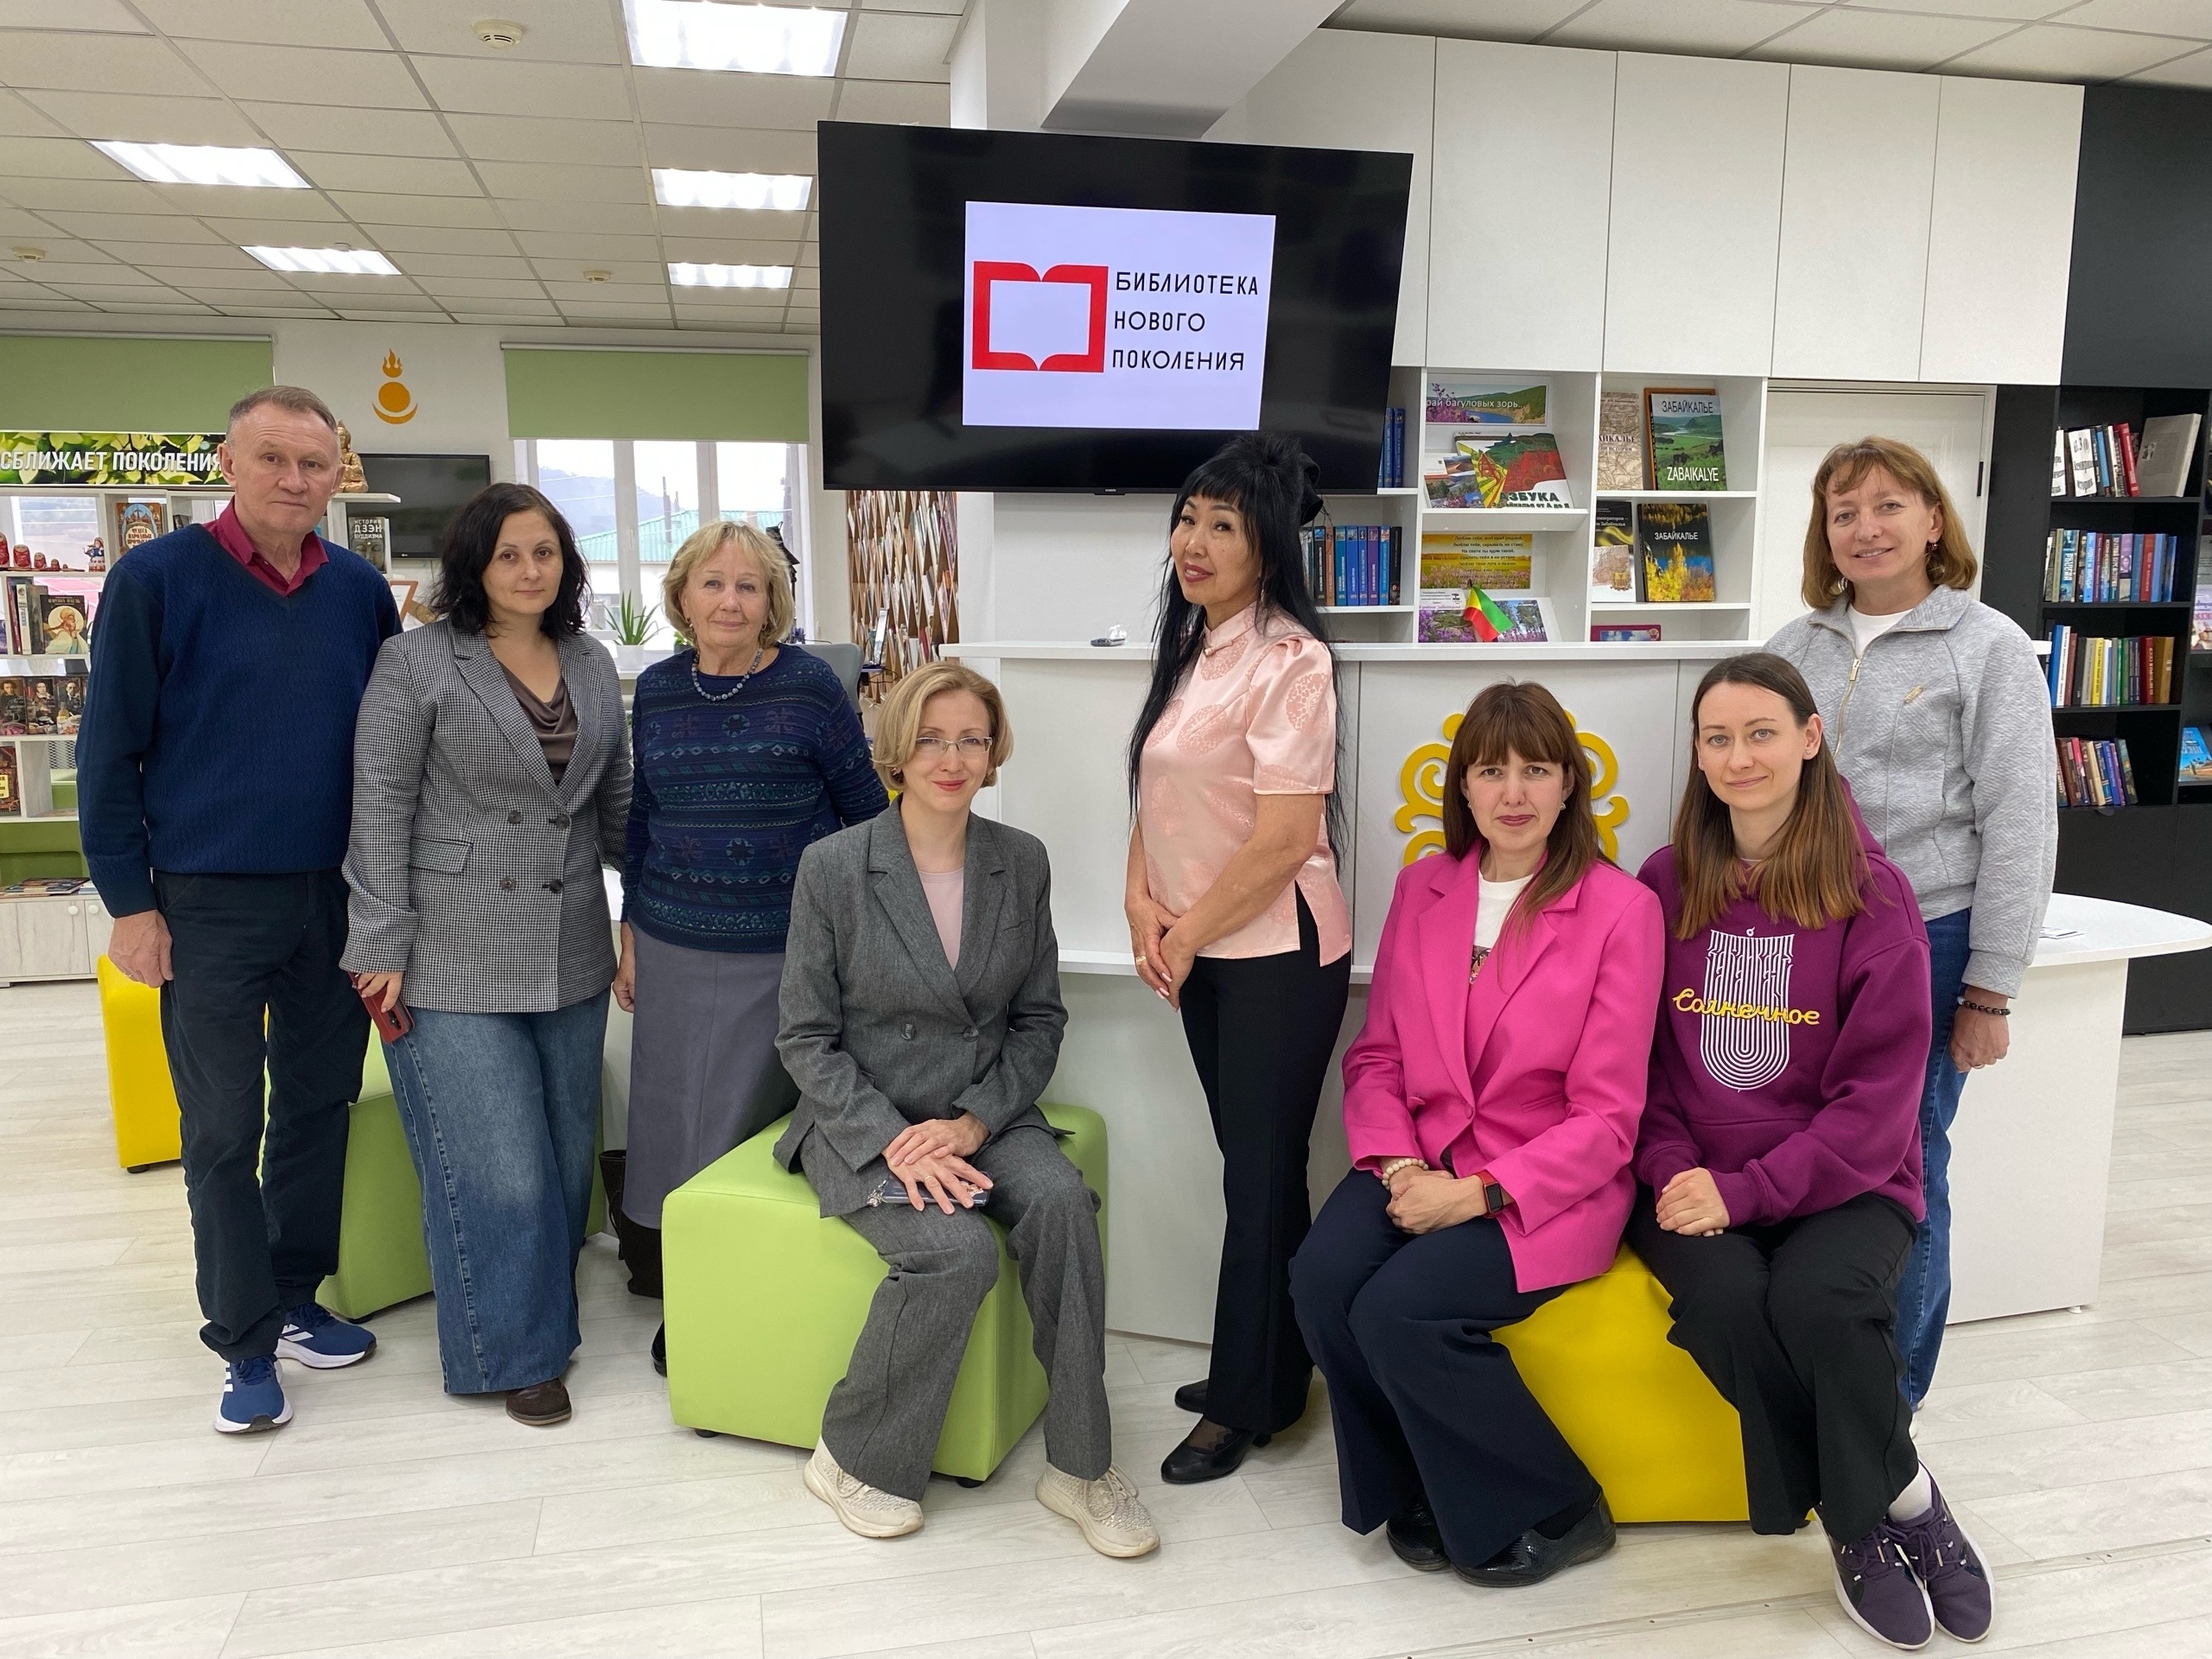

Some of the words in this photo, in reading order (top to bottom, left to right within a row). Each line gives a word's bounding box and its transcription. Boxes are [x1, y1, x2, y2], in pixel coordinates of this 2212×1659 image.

[1116, 271, 1259, 296] БИБЛИОТЕКА
[1114, 310, 1206, 332] НОВОГО
[1112, 349, 1244, 371] ПОКОЛЕНИЯ
[1426, 398, 1443, 407] рай
[1446, 399, 1494, 409] багуловых
[1662, 400, 1714, 414] ЗАБАЙКАЛЬЕ
[0, 451, 107, 471] СБЛИЖАЕТ
[112, 451, 222, 472] ПОКОЛЕНИЯ
[1666, 467, 1719, 481] ZABAIKALYE
[1499, 492, 1560, 502] АЗБУКА
[354, 524, 383, 533] ДЗЭН
[1654, 531, 1699, 540] ЗАБАЙКАЛЬЕ
[1673, 988, 1821, 1026] Солнечное
